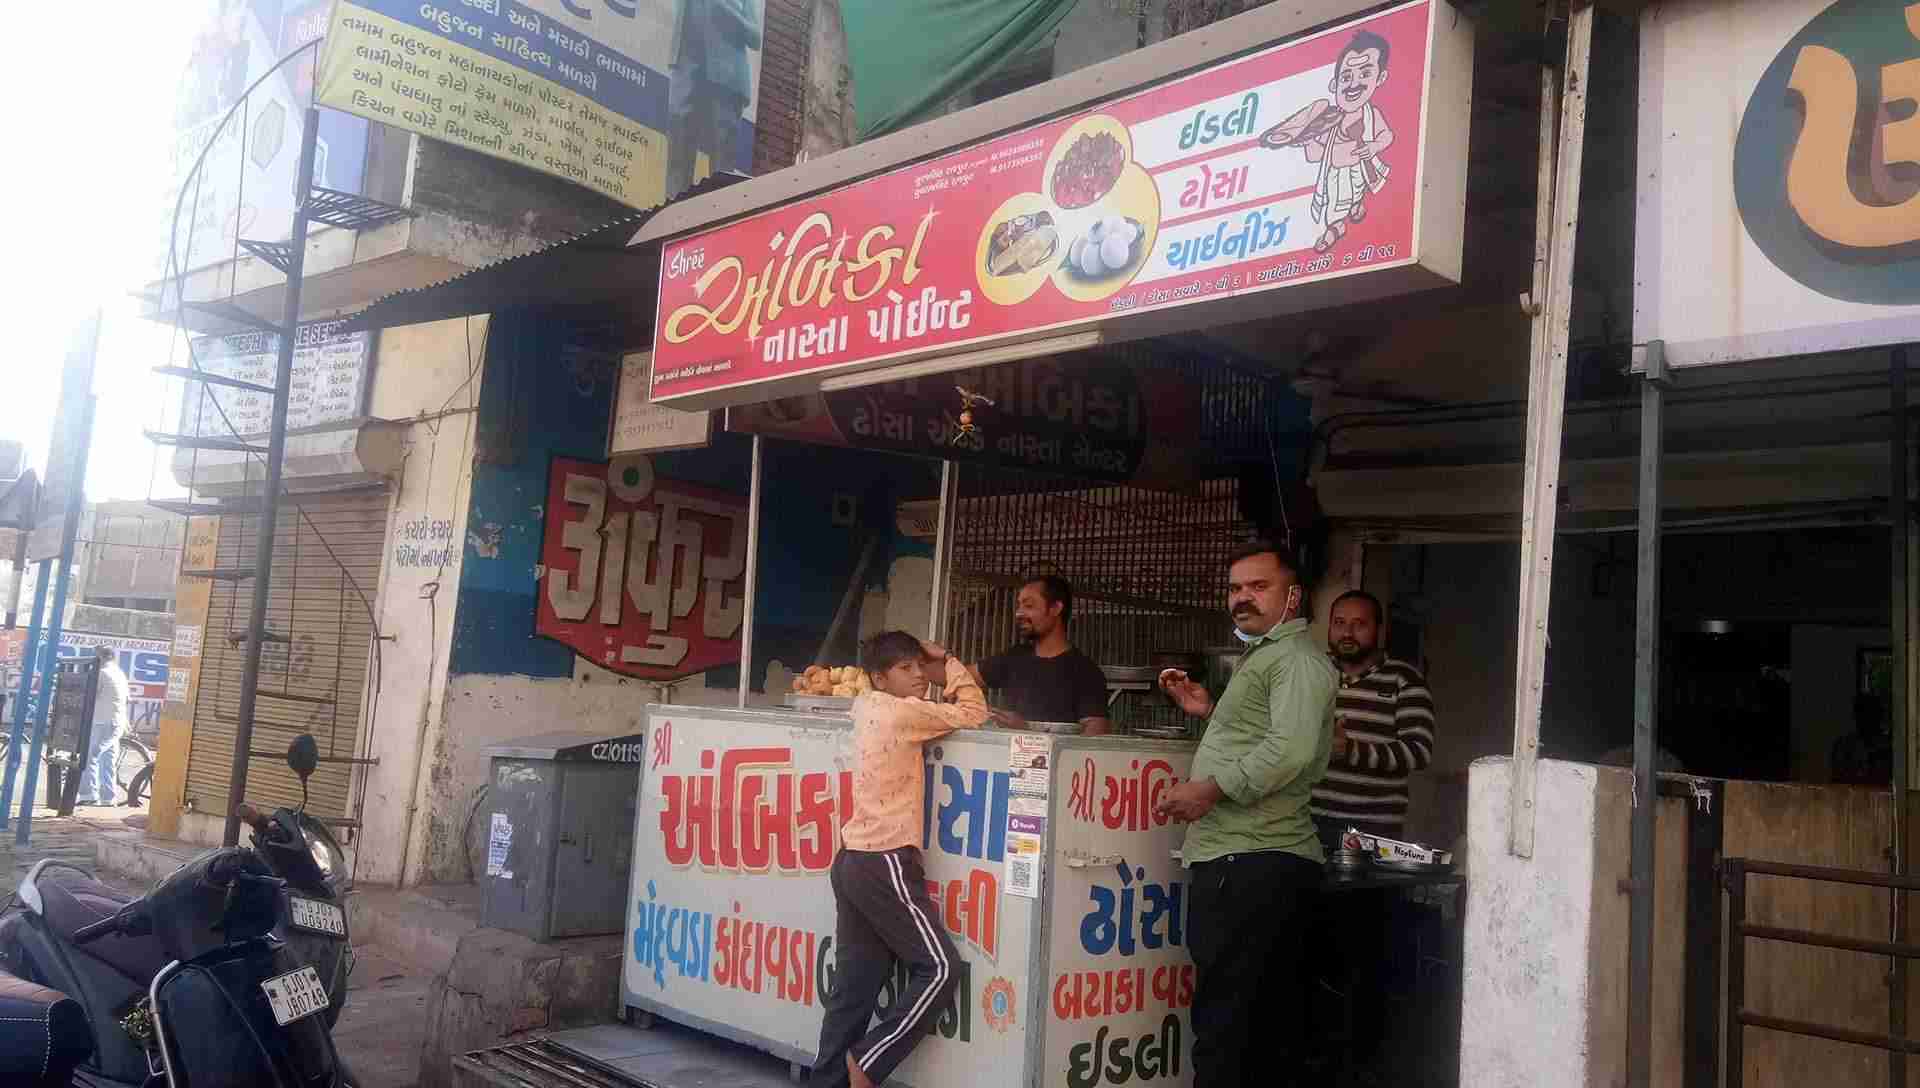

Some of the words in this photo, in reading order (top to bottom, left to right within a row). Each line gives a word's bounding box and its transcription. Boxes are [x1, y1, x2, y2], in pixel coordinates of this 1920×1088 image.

[390, 33, 442, 60] બહુજન
[419, 4, 483, 40] બહુજન
[493, 32, 552, 69] સાહિત્ય
[558, 61, 597, 91] મળશે
[508, 9, 541, 34] અને
[548, 28, 591, 60] મરાઠી
[352, 68, 383, 89] અને
[437, 71, 469, 93] ફોટો
[1178, 92, 1259, 150] ઈડલી
[1179, 163, 1249, 209] ઢોસા
[664, 204, 940, 345] અંબિકા
[667, 246, 705, 280] Shree
[763, 315, 849, 364] નાસ્તા
[867, 287, 972, 343] પોઈન્ટ
[651, 720, 673, 770] શ્રી
[1068, 757, 1095, 823] શ્રી
[1053, 967, 1146, 1021] બટાકા
[1068, 1013, 1182, 1088] ઈડલી
